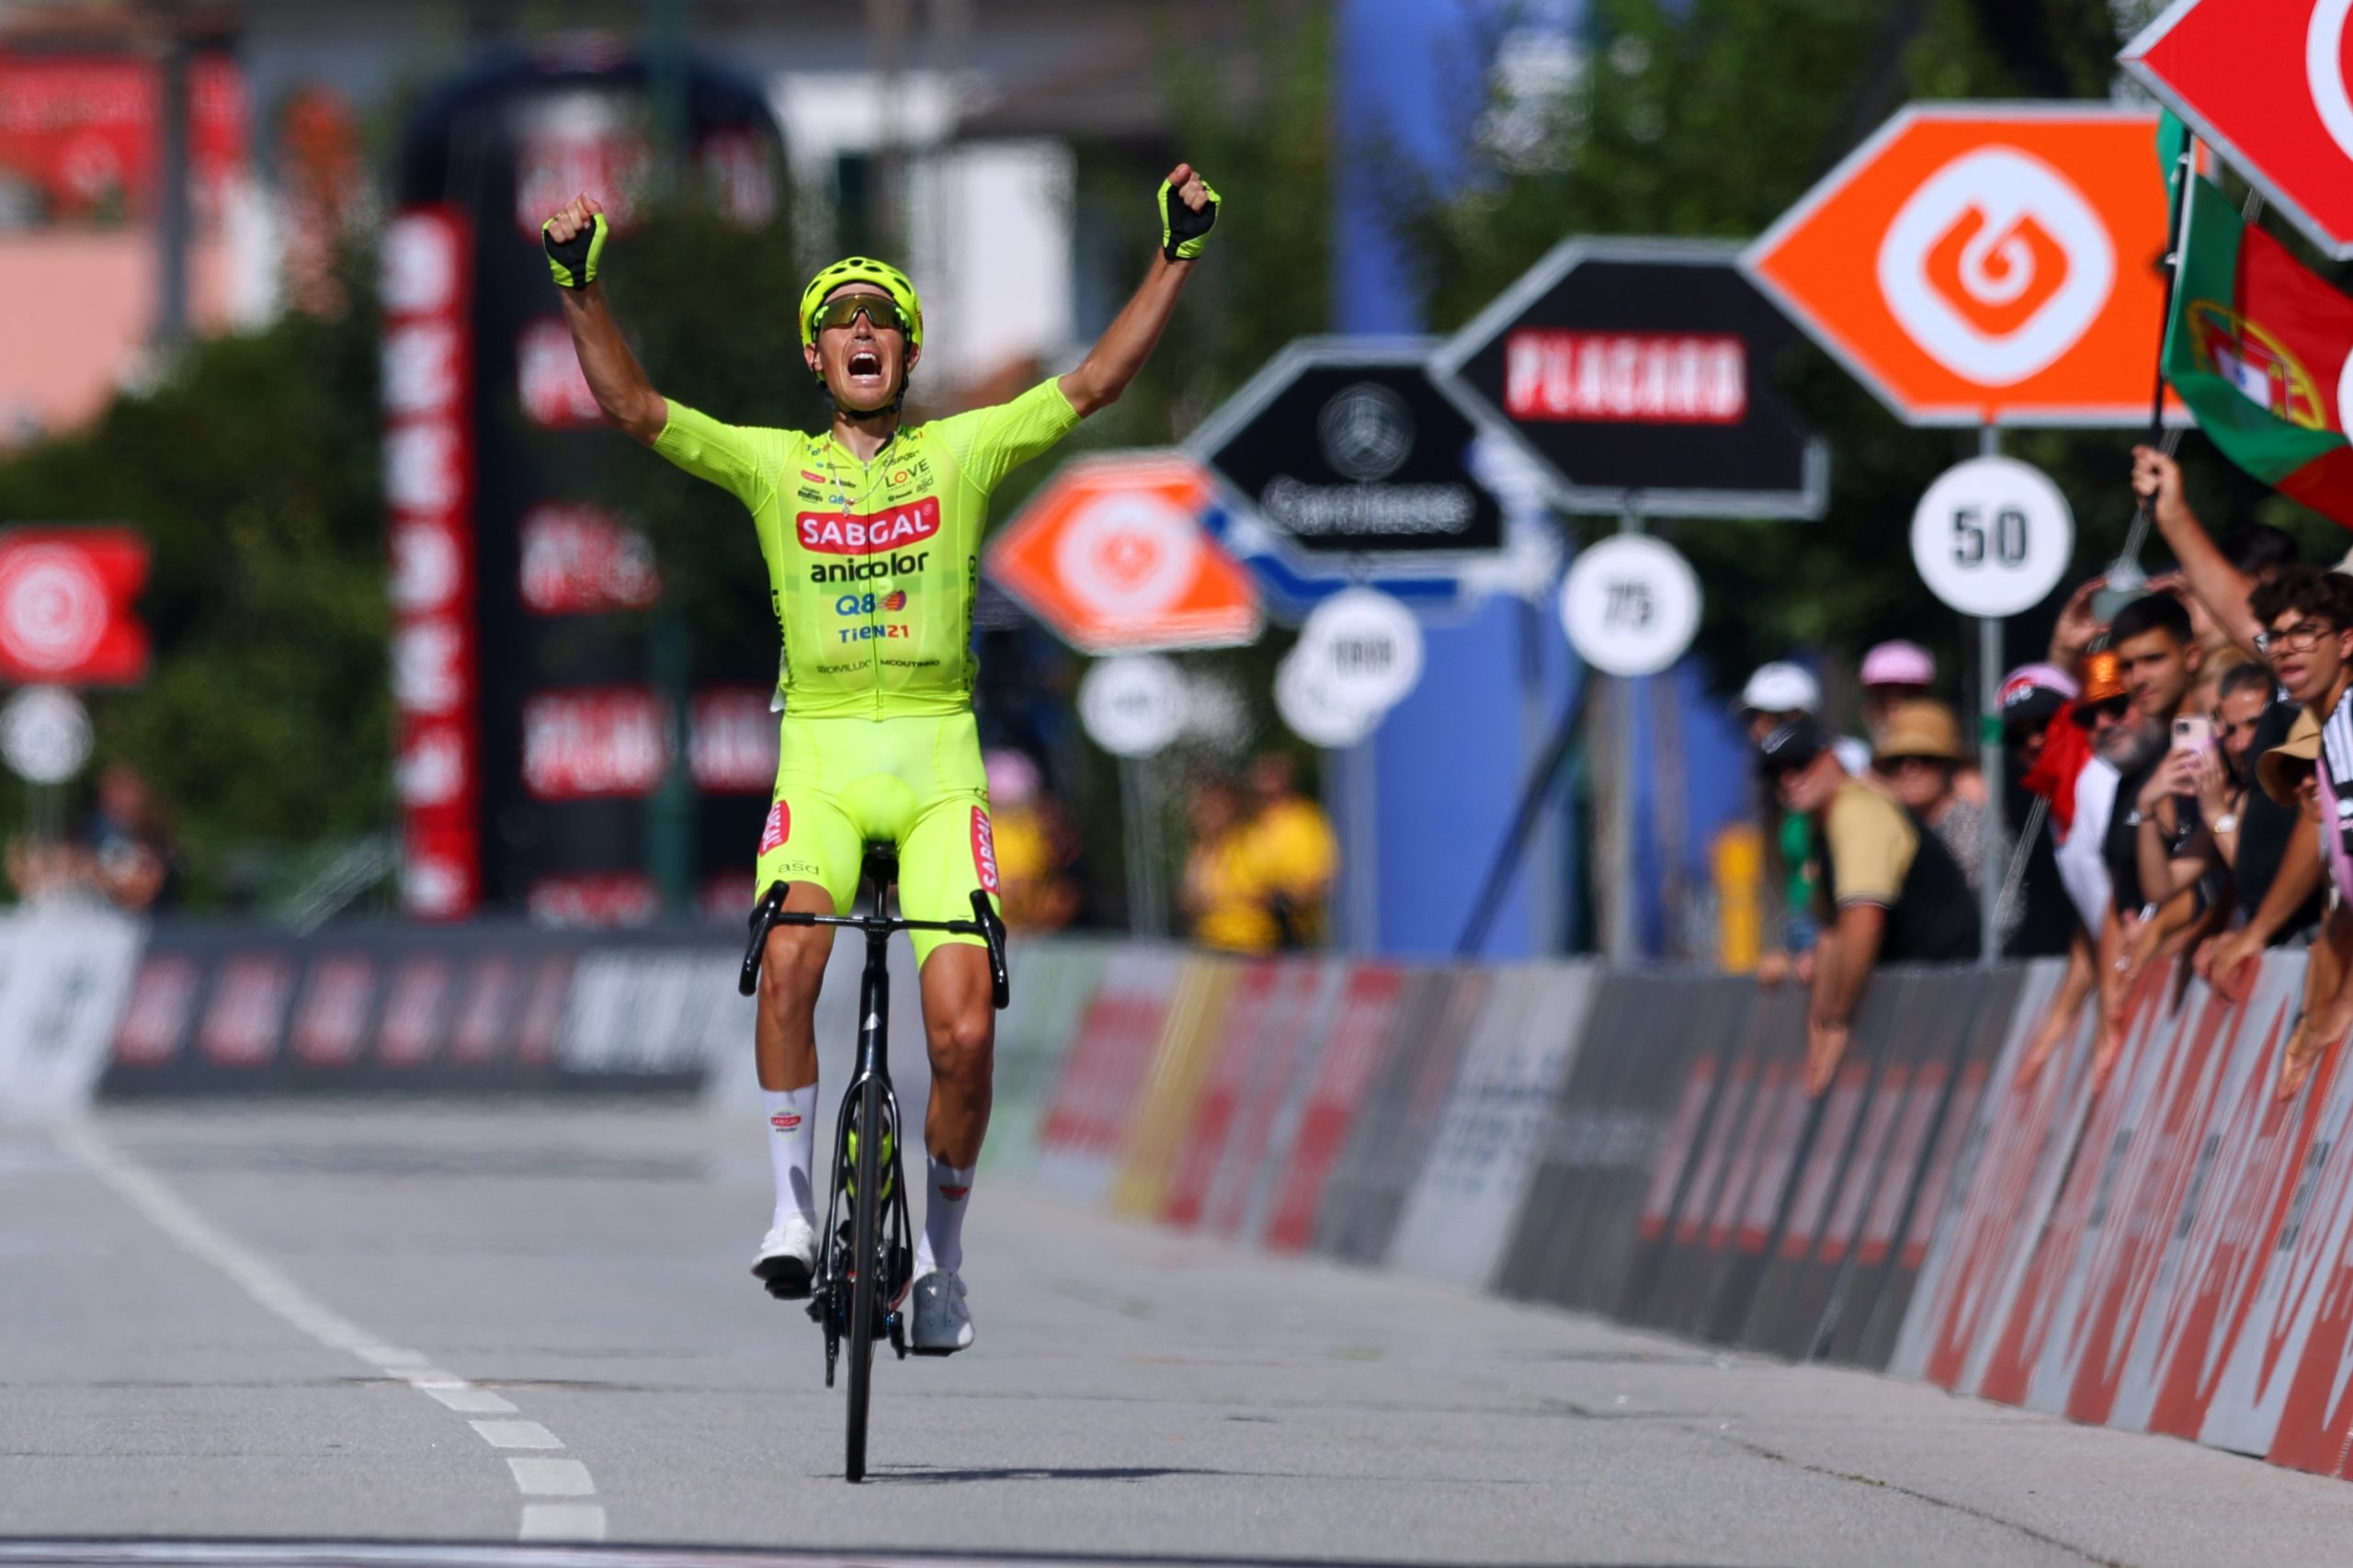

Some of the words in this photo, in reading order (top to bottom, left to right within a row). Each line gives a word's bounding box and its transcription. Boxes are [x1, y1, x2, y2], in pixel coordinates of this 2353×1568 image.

[885, 459, 930, 488] LOVE
[802, 508, 931, 547] SABGAL
[1955, 508, 2027, 566] 50
[811, 551, 929, 583] anicolor
[835, 593, 876, 616] Q8
